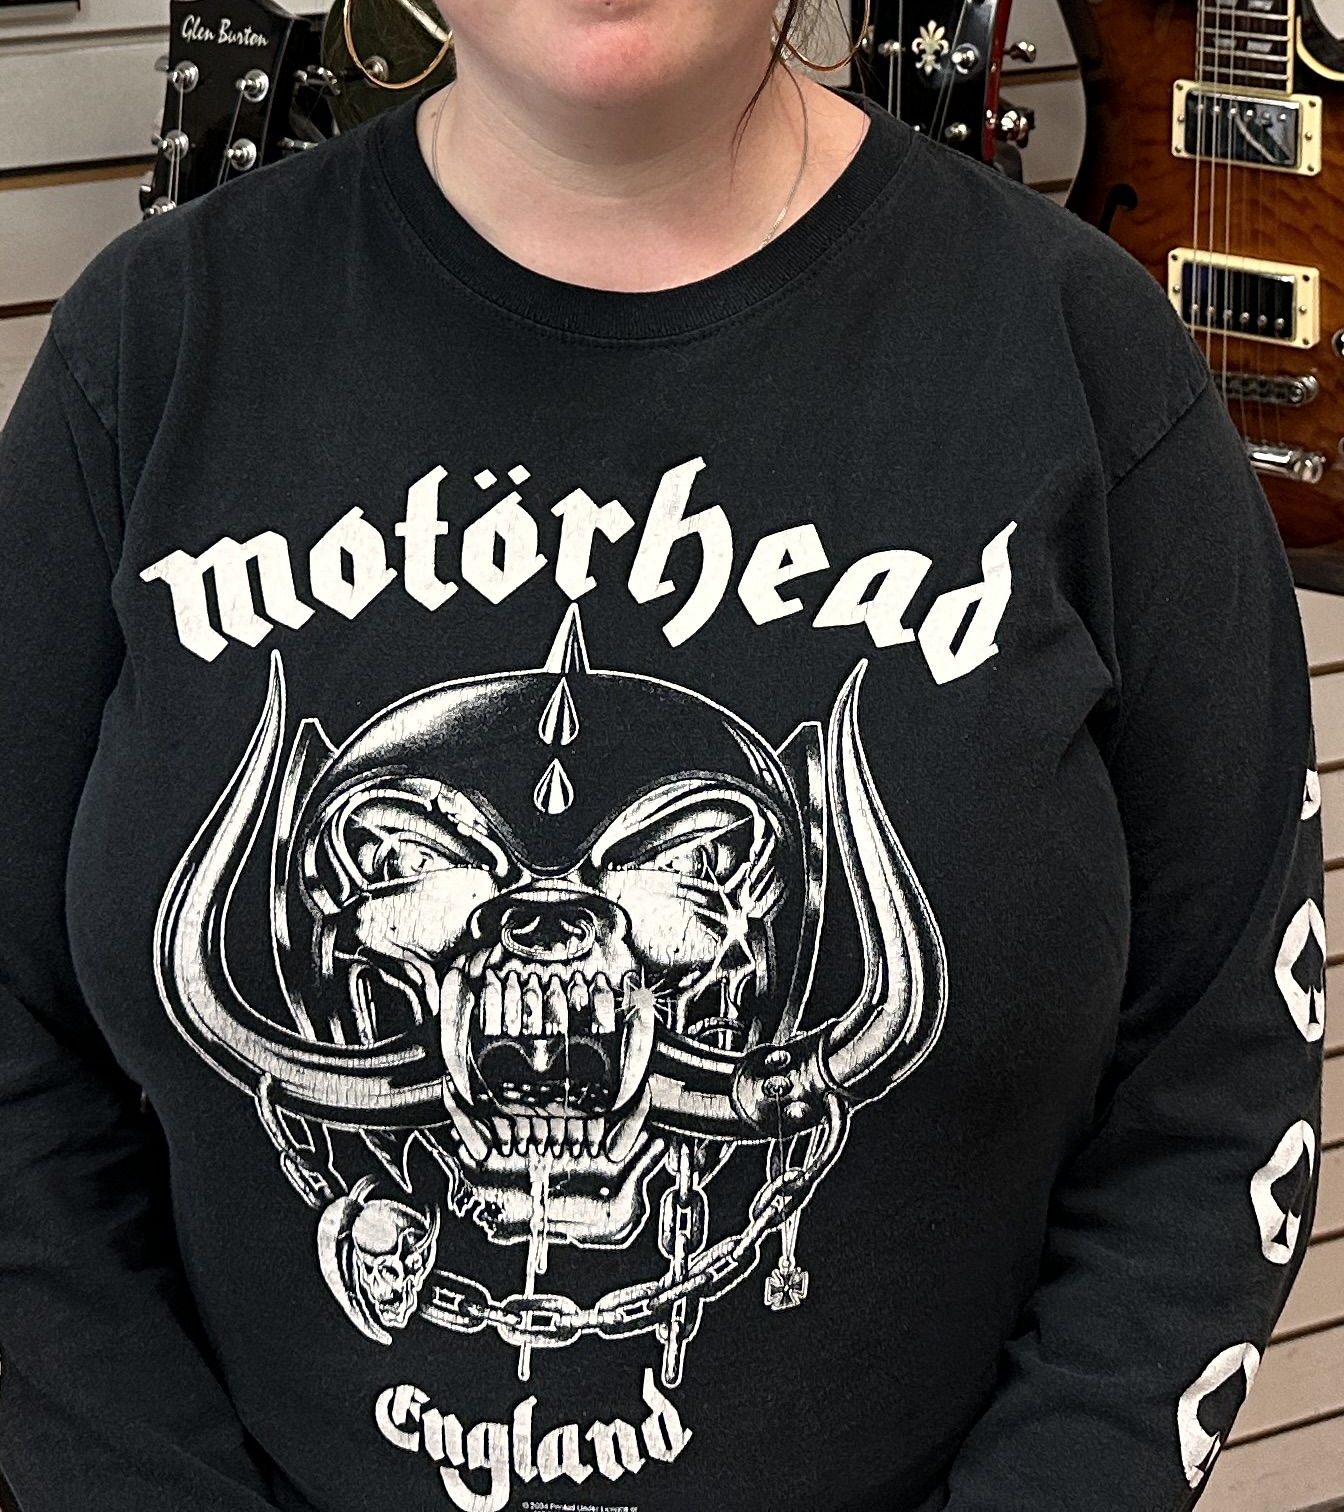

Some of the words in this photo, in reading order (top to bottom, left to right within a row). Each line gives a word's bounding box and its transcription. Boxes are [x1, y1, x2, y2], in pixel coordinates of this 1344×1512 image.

[181, 13, 217, 42] Glen
[217, 17, 270, 48] Burton
[374, 1367, 694, 1512] England
